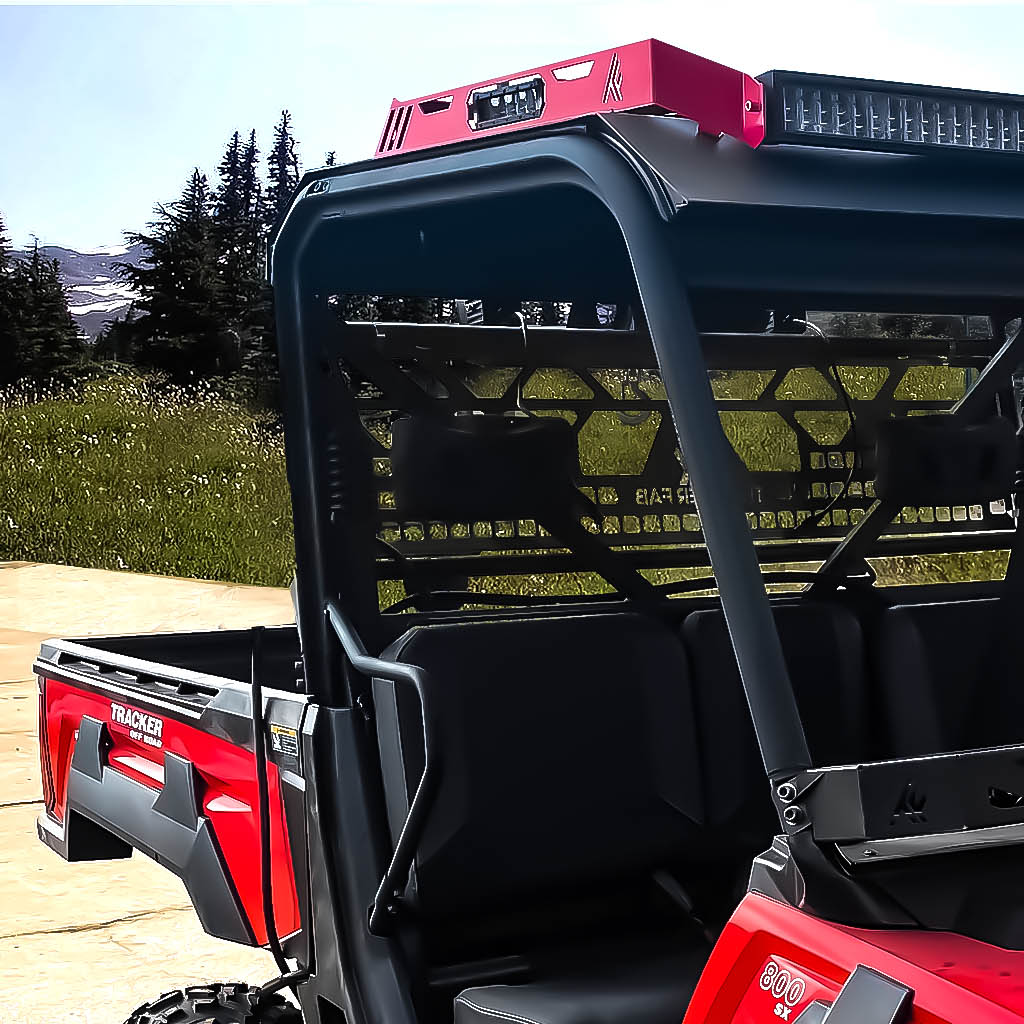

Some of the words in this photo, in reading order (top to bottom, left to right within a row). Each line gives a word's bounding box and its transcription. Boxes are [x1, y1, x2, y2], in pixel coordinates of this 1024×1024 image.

[110, 702, 163, 738] TRACKER
[760, 961, 806, 1007] 800
[773, 1002, 792, 1021] SX
